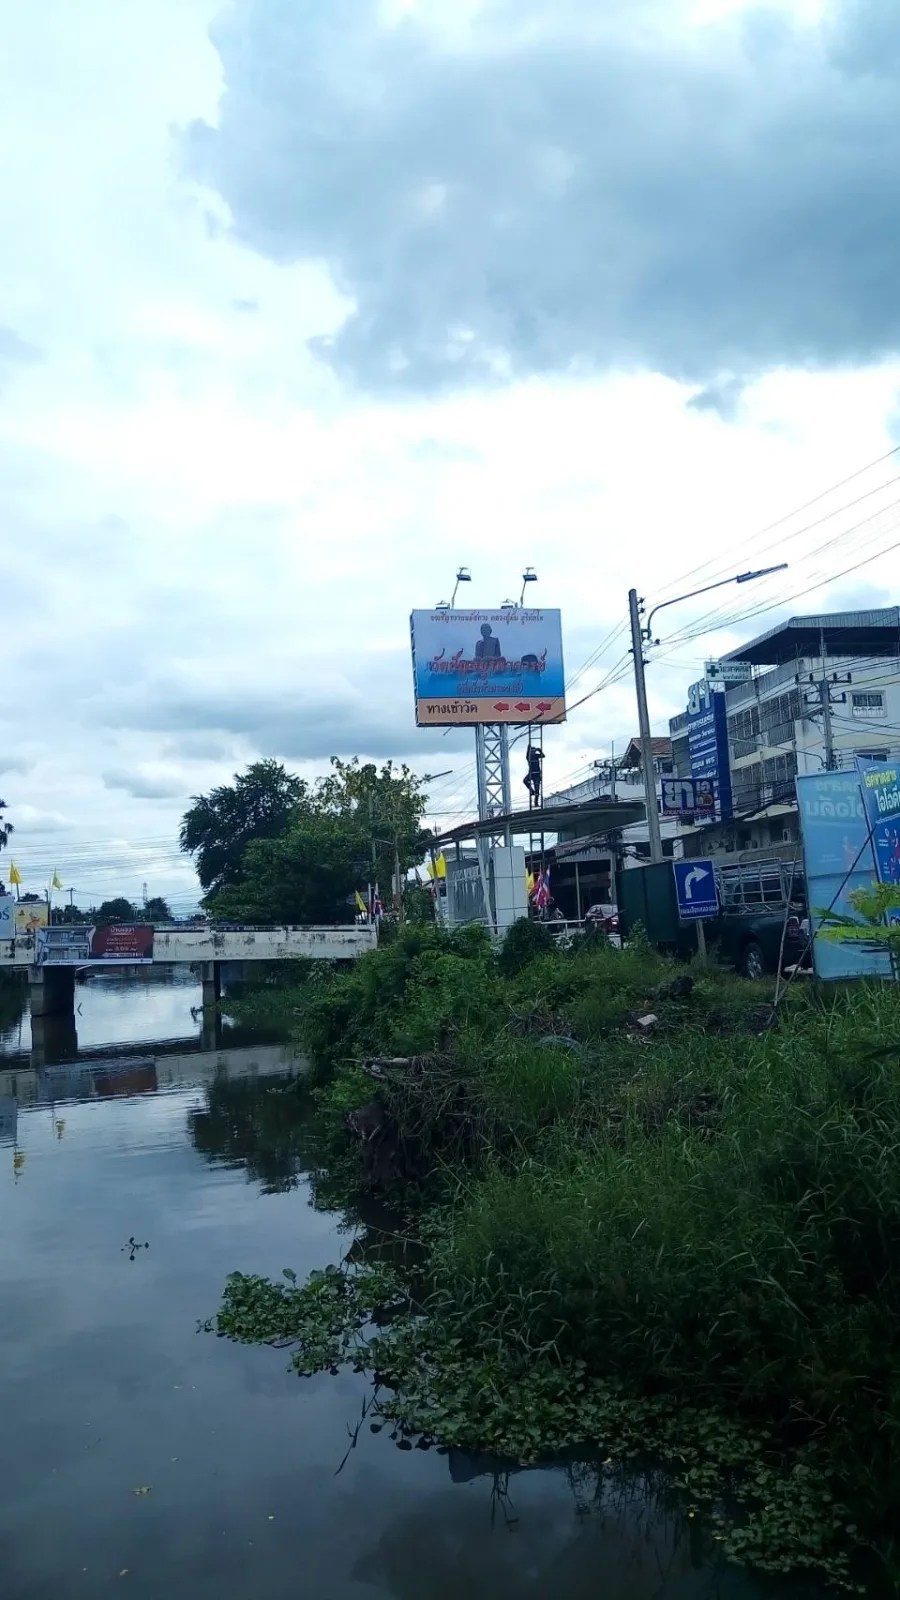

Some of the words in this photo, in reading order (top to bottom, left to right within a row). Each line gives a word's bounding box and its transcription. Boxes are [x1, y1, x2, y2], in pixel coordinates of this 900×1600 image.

[427, 701, 478, 714] ทางเข้าวัด
[688, 679, 711, 715] ยา
[664, 781, 695, 808] ยา
